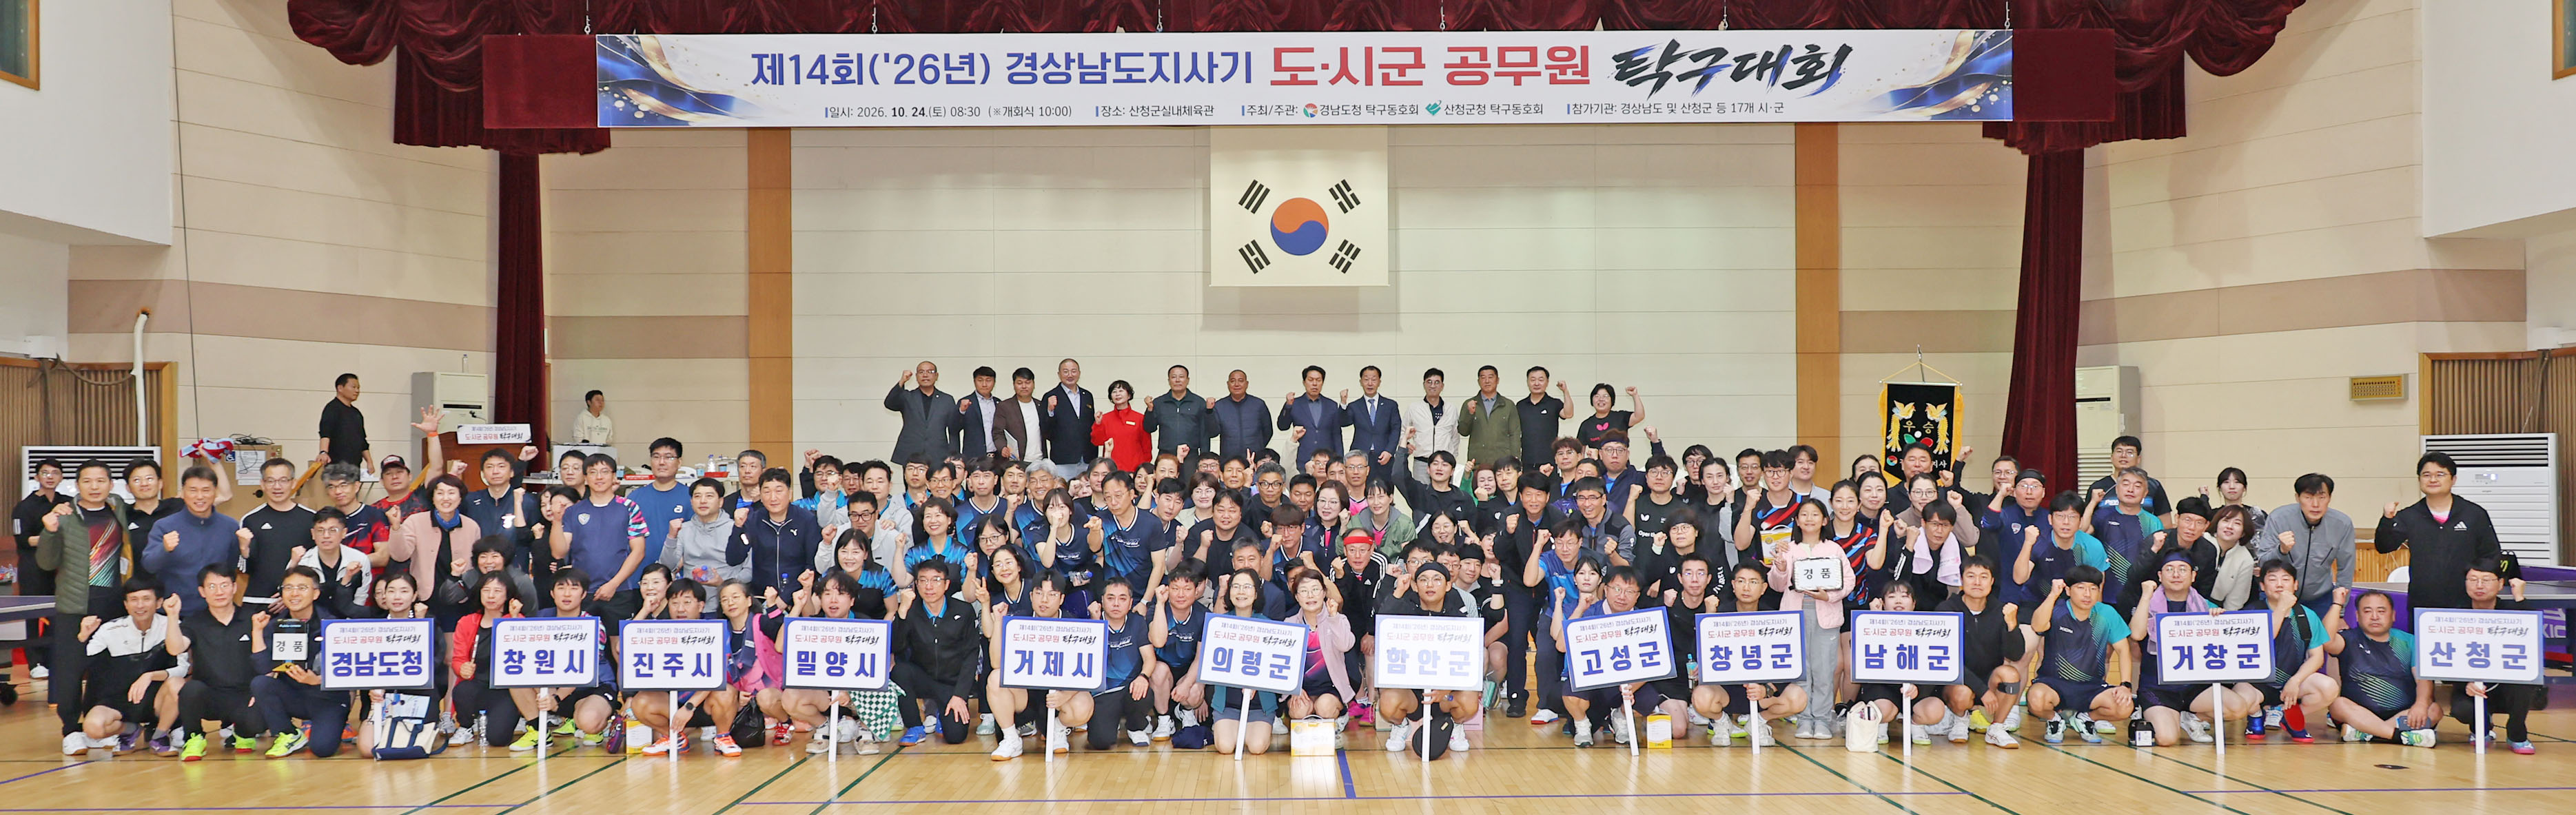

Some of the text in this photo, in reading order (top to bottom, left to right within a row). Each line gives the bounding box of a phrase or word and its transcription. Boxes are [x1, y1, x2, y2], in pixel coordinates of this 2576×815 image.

[751, 39, 1854, 100] 제14회('26년) 경상남도지사기 도·시군 공무원 탁구대회
[828, 107, 853, 118] 일시:
[857, 107, 888, 117] 2026.
[891, 107, 908, 117] 10.
[911, 106, 946, 118] 24.(토)
[950, 106, 981, 117] 08:30
[1039, 105, 1072, 117] 10:00)
[1101, 105, 1125, 117] 장소:
[1129, 105, 1214, 116] 산청군실내체육관
[1247, 105, 1298, 116] 주최/주관:
[1320, 104, 1362, 116] 경남도청
[1365, 104, 1418, 116] 탁구동호회
[1444, 104, 1486, 116] 산청군청
[1490, 103, 1543, 115] 탁구동호회
[1572, 103, 1617, 115] 참가기관:
[1621, 103, 1662, 114] 경상남도
[1666, 103, 1677, 114] 및
[1680, 103, 1713, 114] 산청군
[1716, 102, 1727, 114] 등
[1731, 102, 1755, 114] 17개
[1757, 102, 1784, 114] 시·군
[360, 636, 382, 644] 공무원
[385, 634, 421, 643] 탁구대회
[529, 634, 551, 642] 공무원
[553, 632, 588, 641] 탁구대회
[656, 637, 678, 645] 공무원
[681, 635, 715, 645] 탁구대회
[820, 635, 842, 643] 공무원
[845, 635, 879, 645] 탁구대회
[1038, 635, 1060, 643] 공무원
[1063, 634, 1096, 645] 탁구대회
[1238, 633, 1260, 643] 공무원
[1263, 635, 1296, 647] 탁구대회
[1412, 633, 1434, 641] 공무원
[1437, 632, 1473, 643] 탁구대회
[1600, 630, 1622, 640] 공무원
[1624, 623, 1657, 636] 탁구대회
[1733, 629, 1755, 638] 공무원
[1758, 626, 1793, 637] 탁구대회
[1890, 628, 1912, 637] 공무원
[1915, 627, 1951, 637] 탁구대회
[2196, 628, 2220, 637] 공무원
[2222, 626, 2260, 636] 탁구대회
[2457, 626, 2484, 635] 공무원
[2487, 626, 2529, 637] 탁구대회
[331, 650, 422, 677] 경남도청
[503, 649, 584, 675] 창원시
[633, 652, 712, 678] 진주시
[797, 650, 876, 678] 밀양시
[1013, 650, 1093, 679] 거제시
[1211, 646, 1291, 681] 의령군
[1386, 647, 1471, 677] 함안군
[1580, 641, 1661, 676] 고성군
[1710, 643, 1792, 672] 창녕군
[1865, 643, 1950, 671] 남해군
[2171, 643, 2260, 670] 거창군
[2429, 641, 2528, 670] 산청군
